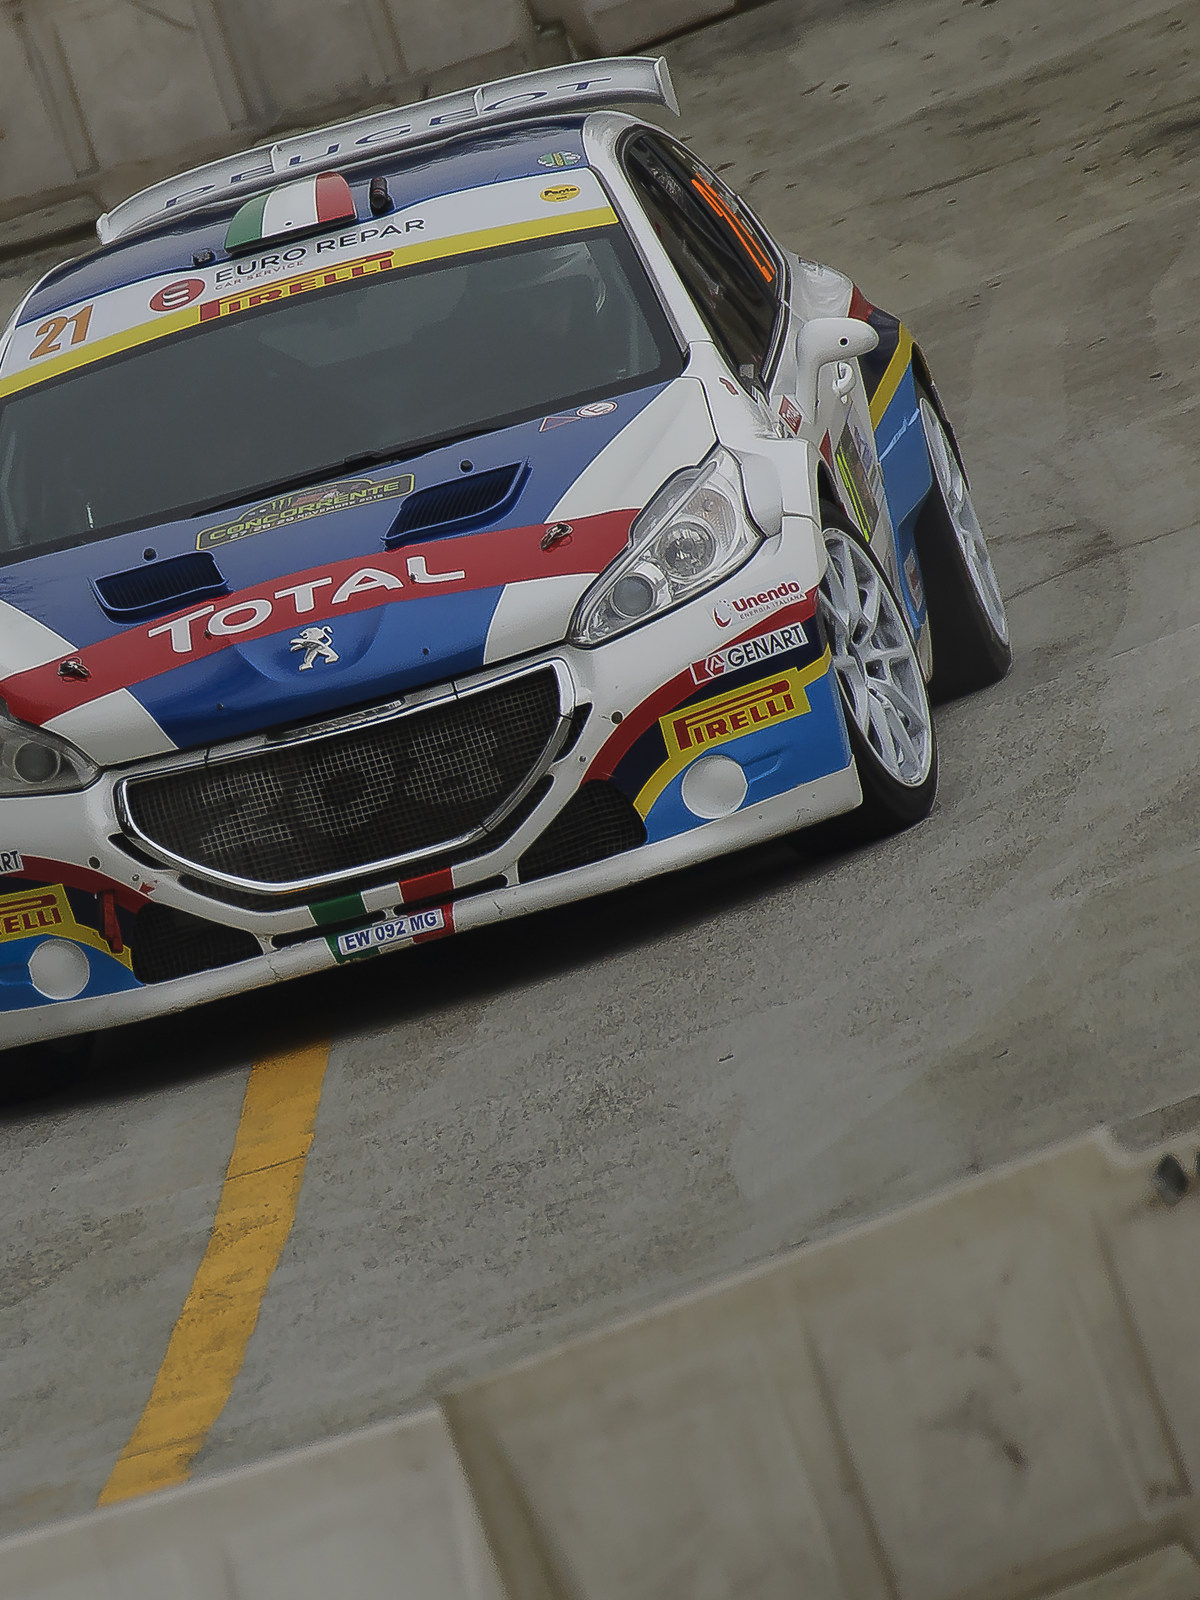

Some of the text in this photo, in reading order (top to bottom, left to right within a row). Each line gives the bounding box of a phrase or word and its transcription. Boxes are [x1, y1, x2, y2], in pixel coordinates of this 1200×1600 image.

[215, 261, 304, 291] CAR SERVICE
[216, 219, 426, 283] EURO REPAR
[200, 250, 394, 322] PIRELLI
[29, 304, 94, 360] 21
[209, 481, 400, 541] CONCORRENTE
[148, 556, 465, 653] TOTAL
[732, 582, 800, 612] Unendo
[740, 594, 804, 619] ENERGIA ITALIANA
[727, 626, 803, 667] GENART
[672, 679, 795, 750] PIRELLI
[201, 725, 498, 855] 208
[345, 912, 437, 951] EW 092 MG
